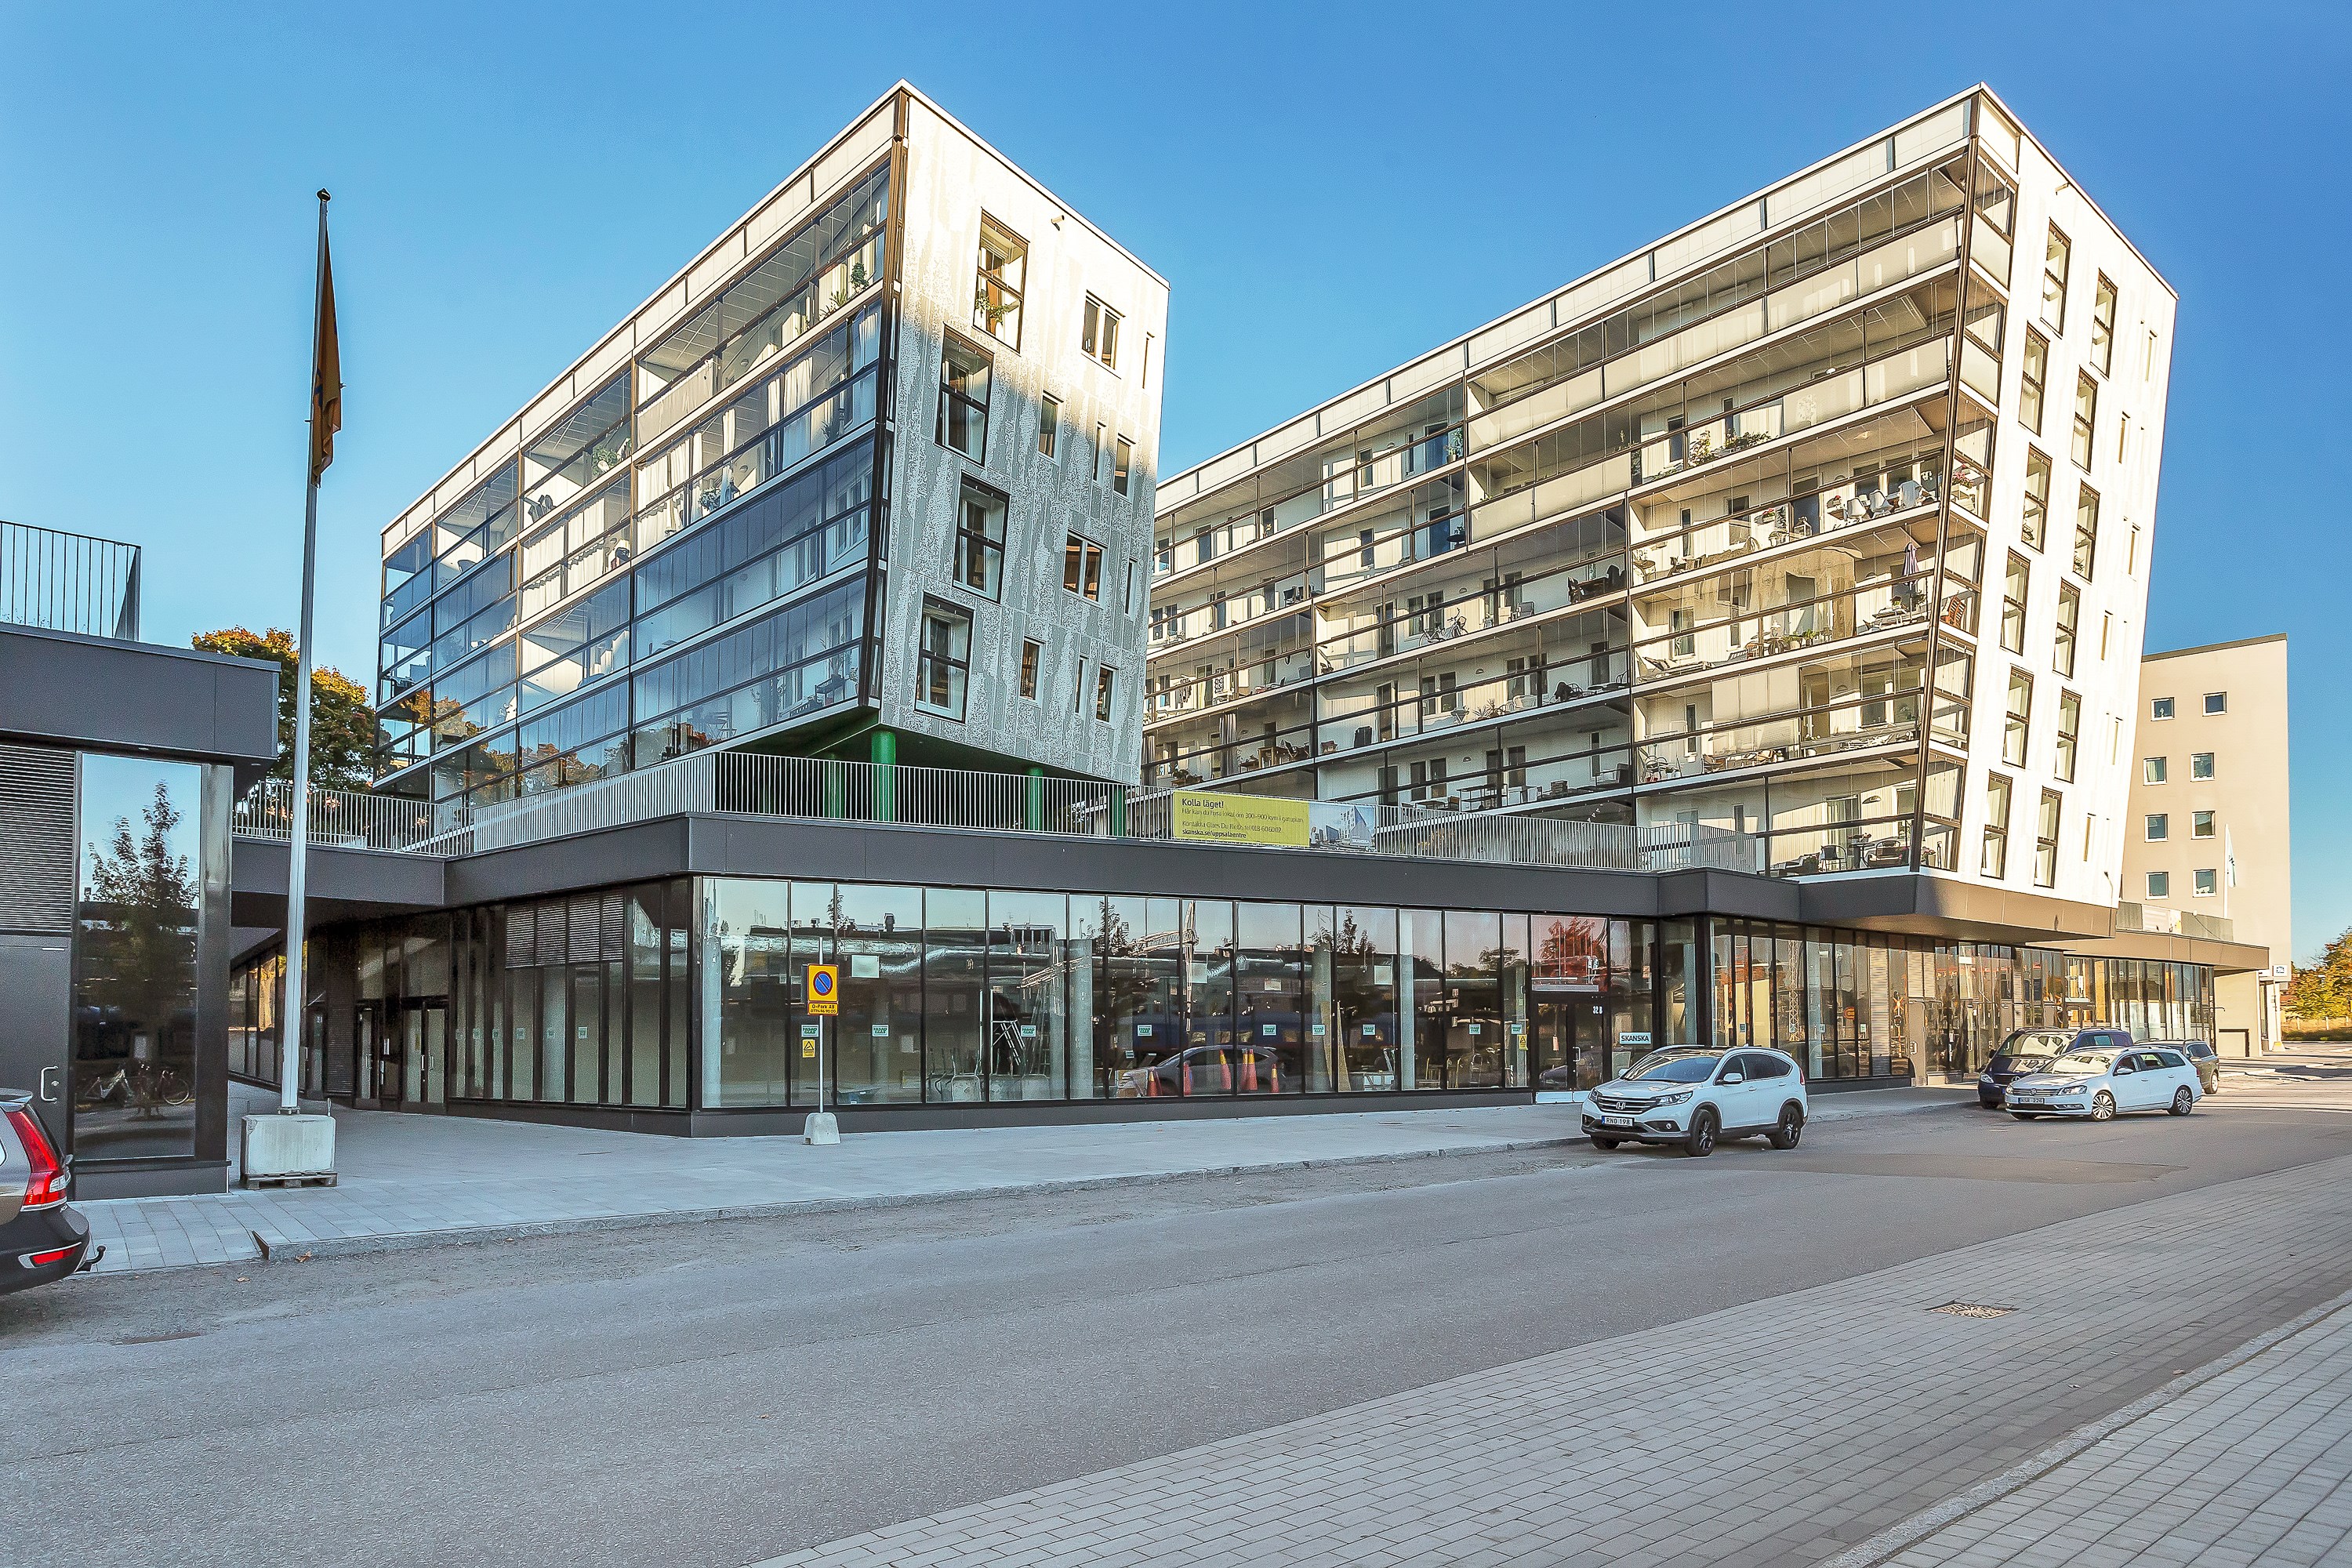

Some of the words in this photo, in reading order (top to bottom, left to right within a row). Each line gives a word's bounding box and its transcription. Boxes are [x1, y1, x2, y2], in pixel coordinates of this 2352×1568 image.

[1181, 798, 1201, 807] Kolla
[1203, 799, 1224, 810] läget!
[1592, 1005, 1599, 1014] 32
